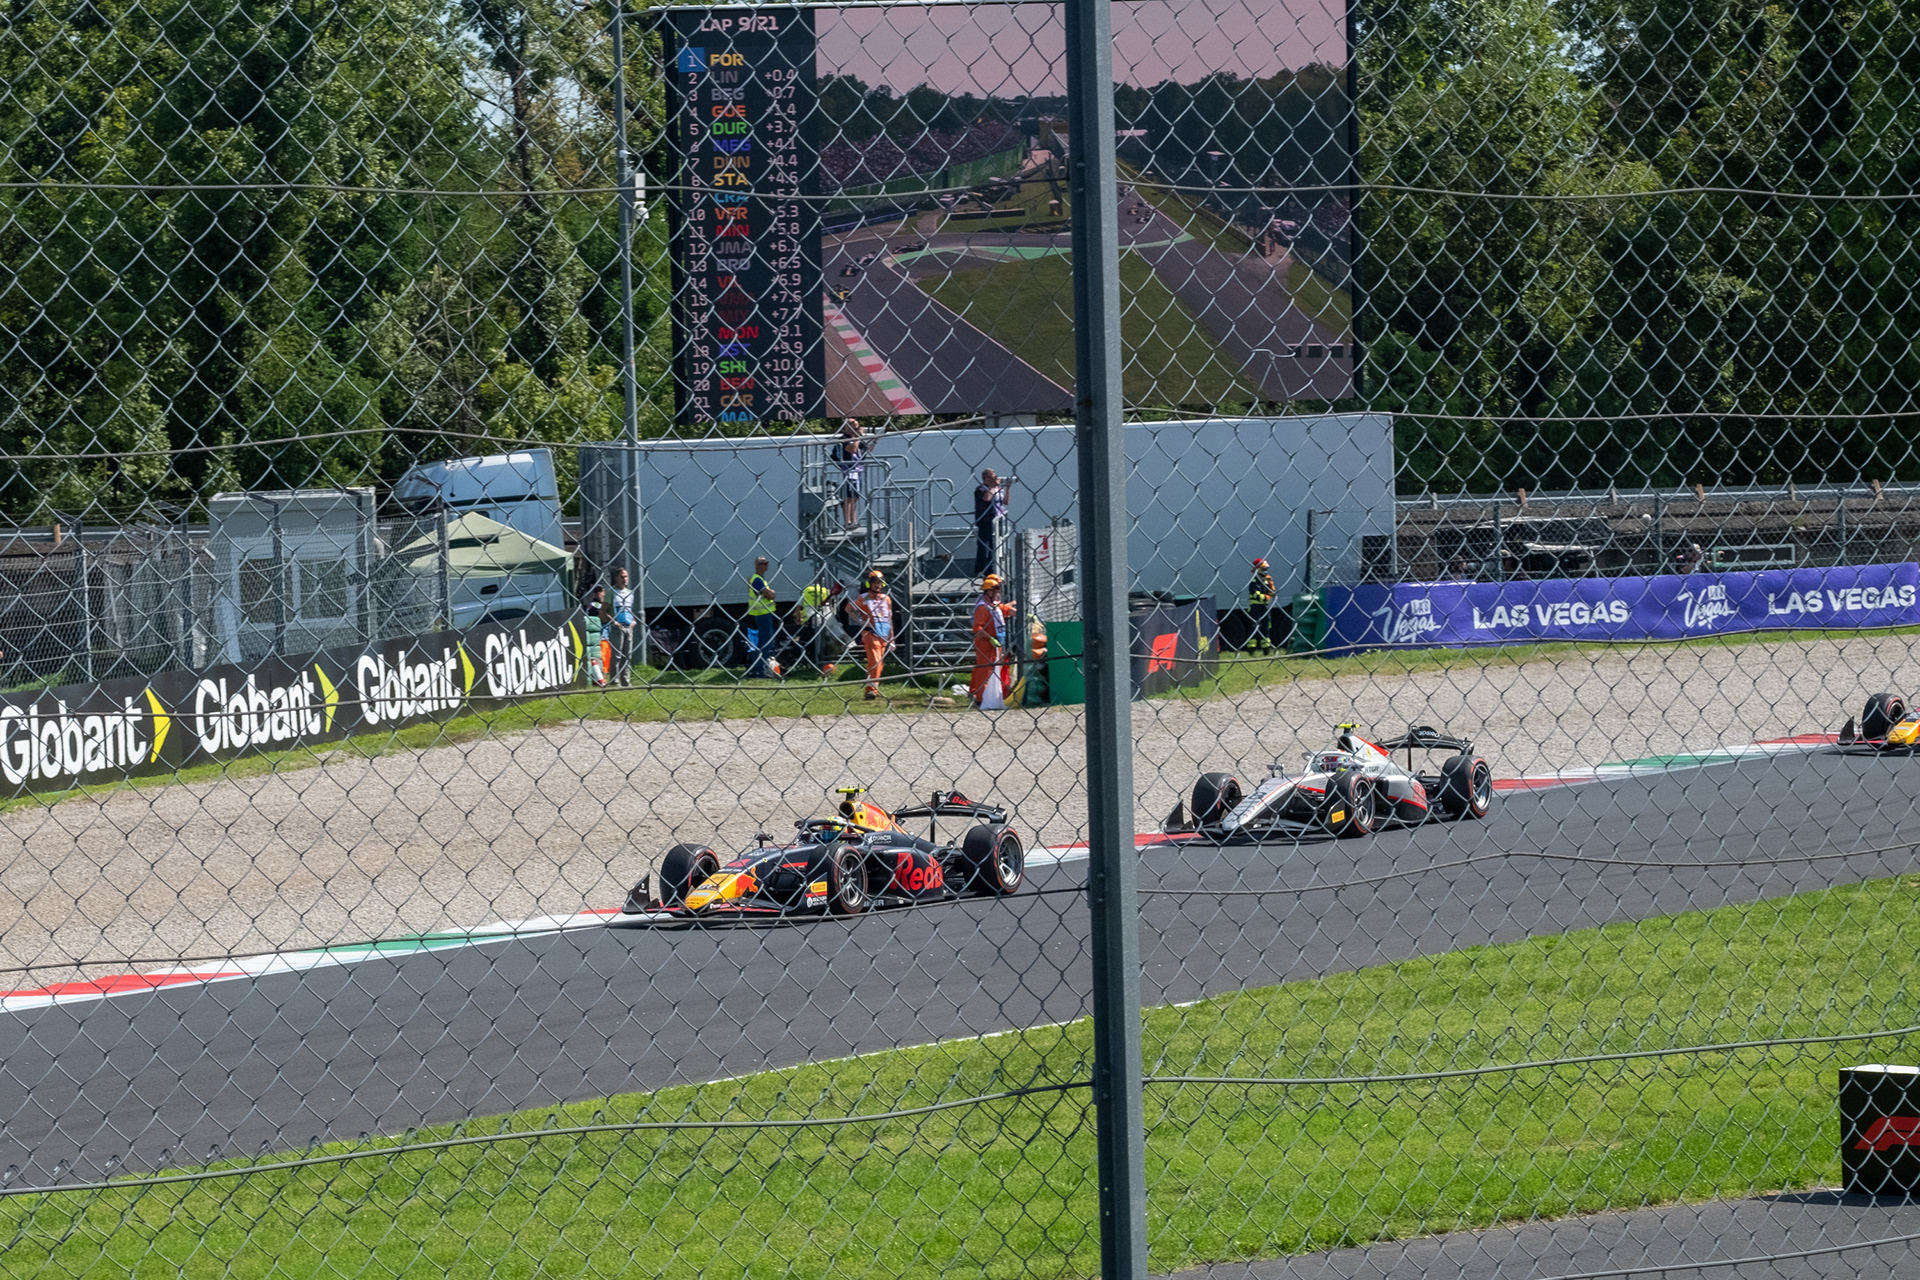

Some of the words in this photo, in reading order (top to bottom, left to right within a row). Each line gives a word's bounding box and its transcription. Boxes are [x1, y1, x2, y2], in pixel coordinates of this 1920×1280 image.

[701, 18, 733, 32] LAP
[738, 15, 779, 33] 9/21
[688, 55, 697, 68] 1
[710, 53, 744, 67] FOR
[688, 72, 698, 85] 2
[710, 70, 738, 84] LIN
[765, 69, 796, 82] +0.4
[688, 89, 698, 102] 3
[711, 88, 745, 101] BEG
[765, 86, 795, 99] +0.7
[690, 106, 698, 117] 4
[712, 104, 746, 118] GOE
[690, 123, 699, 135] 5
[712, 121, 747, 135] DUR
[690, 141, 699, 153] 6
[713, 138, 751, 152] MEG
[690, 158, 699, 170] 7
[767, 154, 798, 167] +4.4
[714, 173, 748, 186] STA
[692, 192, 701, 204] 9
[689, 208, 706, 221] 10
[714, 207, 748, 220] VER
[770, 205, 799, 218] +5.3
[689, 226, 706, 238] 11
[770, 222, 800, 235] +5.8
[689, 243, 707, 256] 12
[716, 241, 752, 255] JMA
[690, 260, 707, 272] 13
[770, 257, 801, 269] +6.5
[772, 307, 802, 320] +77
[692, 328, 709, 341] 17
[772, 324, 803, 337] +9.1
[773, 341, 803, 354] +99
[693, 362, 710, 374] 19
[719, 360, 747, 373] SHI
[1769, 590, 1824, 615] LAS
[1826, 585, 1917, 611] VEGAS
[1473, 604, 1530, 629] LAS
[1535, 600, 1630, 626] VEGAS
[1372, 602, 1442, 645] Vegas
[485, 627, 573, 700] Globant
[357, 647, 461, 725] Globant
[195, 674, 322, 754] Globant
[0, 696, 147, 785] Globant
